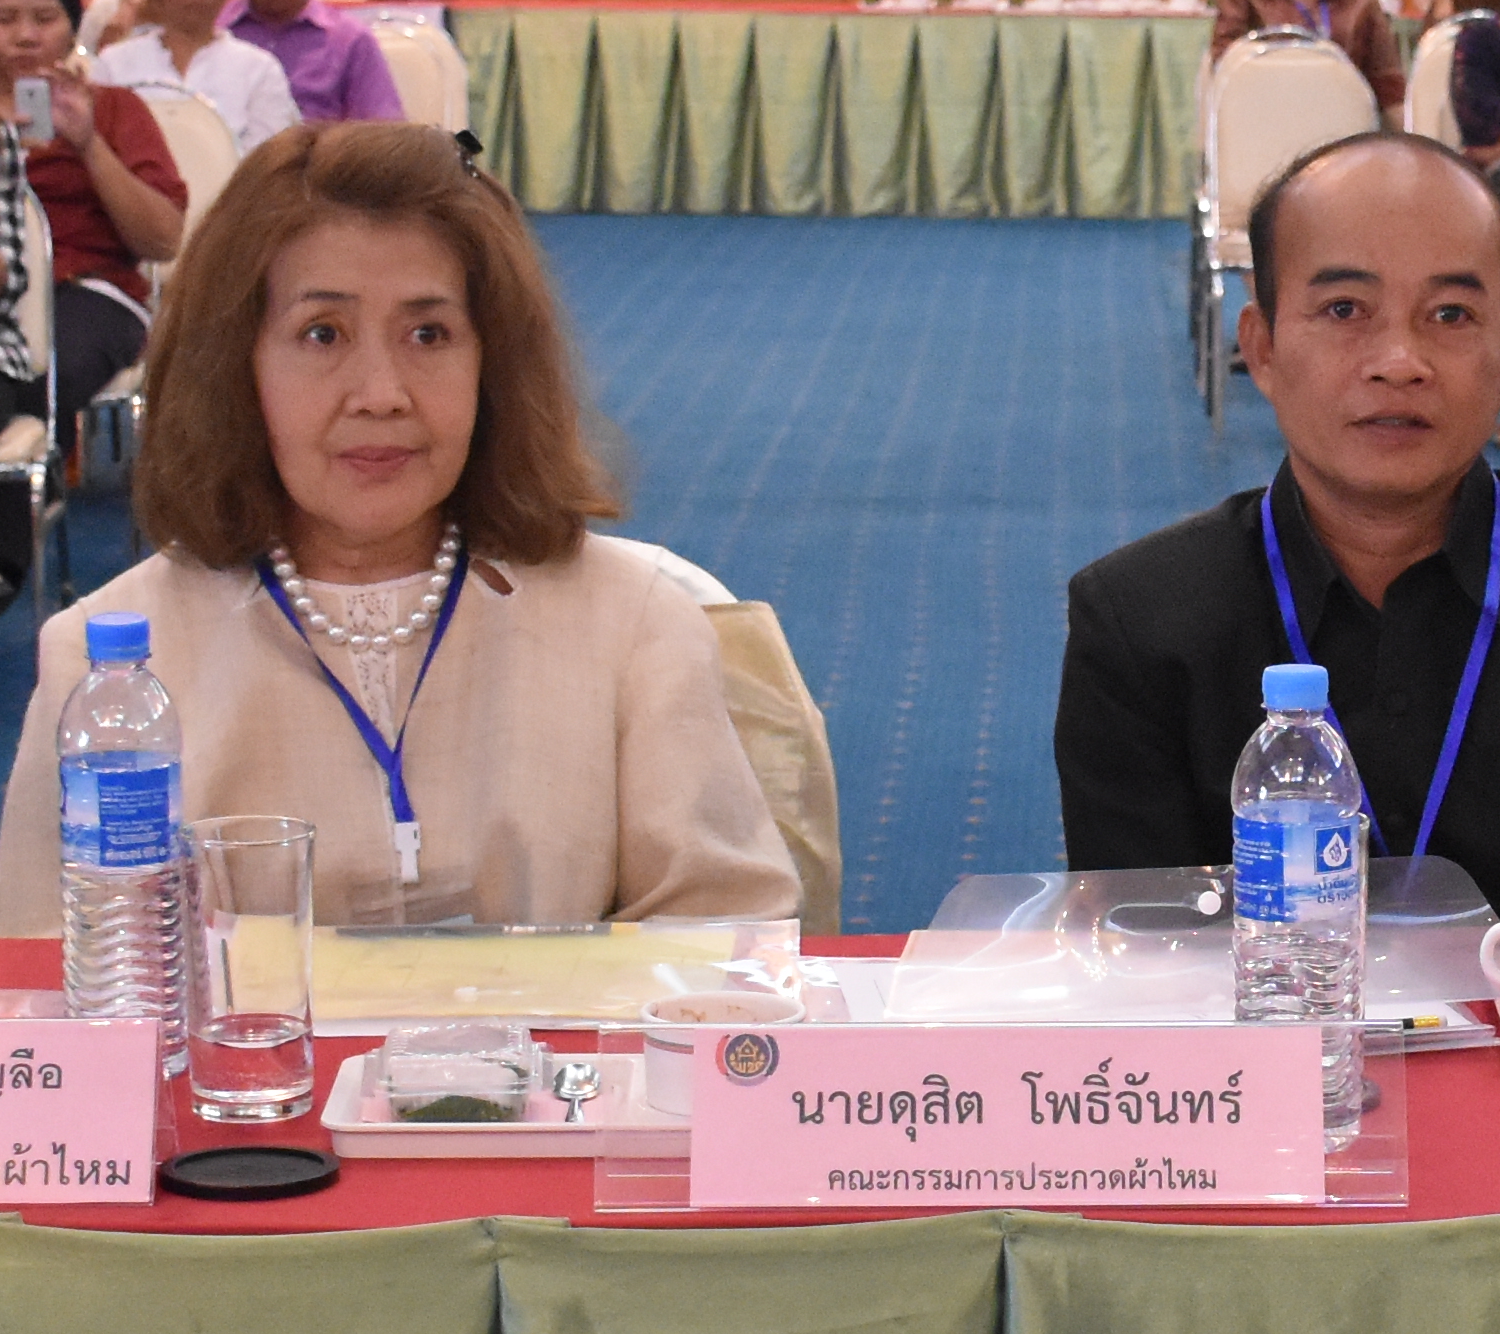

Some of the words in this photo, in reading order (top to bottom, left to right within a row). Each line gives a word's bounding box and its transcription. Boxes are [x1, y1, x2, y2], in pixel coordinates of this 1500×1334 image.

[791, 1074, 984, 1143] นายดุสิต
[1020, 1057, 1244, 1125] โพธิ์จันทร์
[828, 1157, 1217, 1192] คณะกรรมการประกวดผ้าไหม
